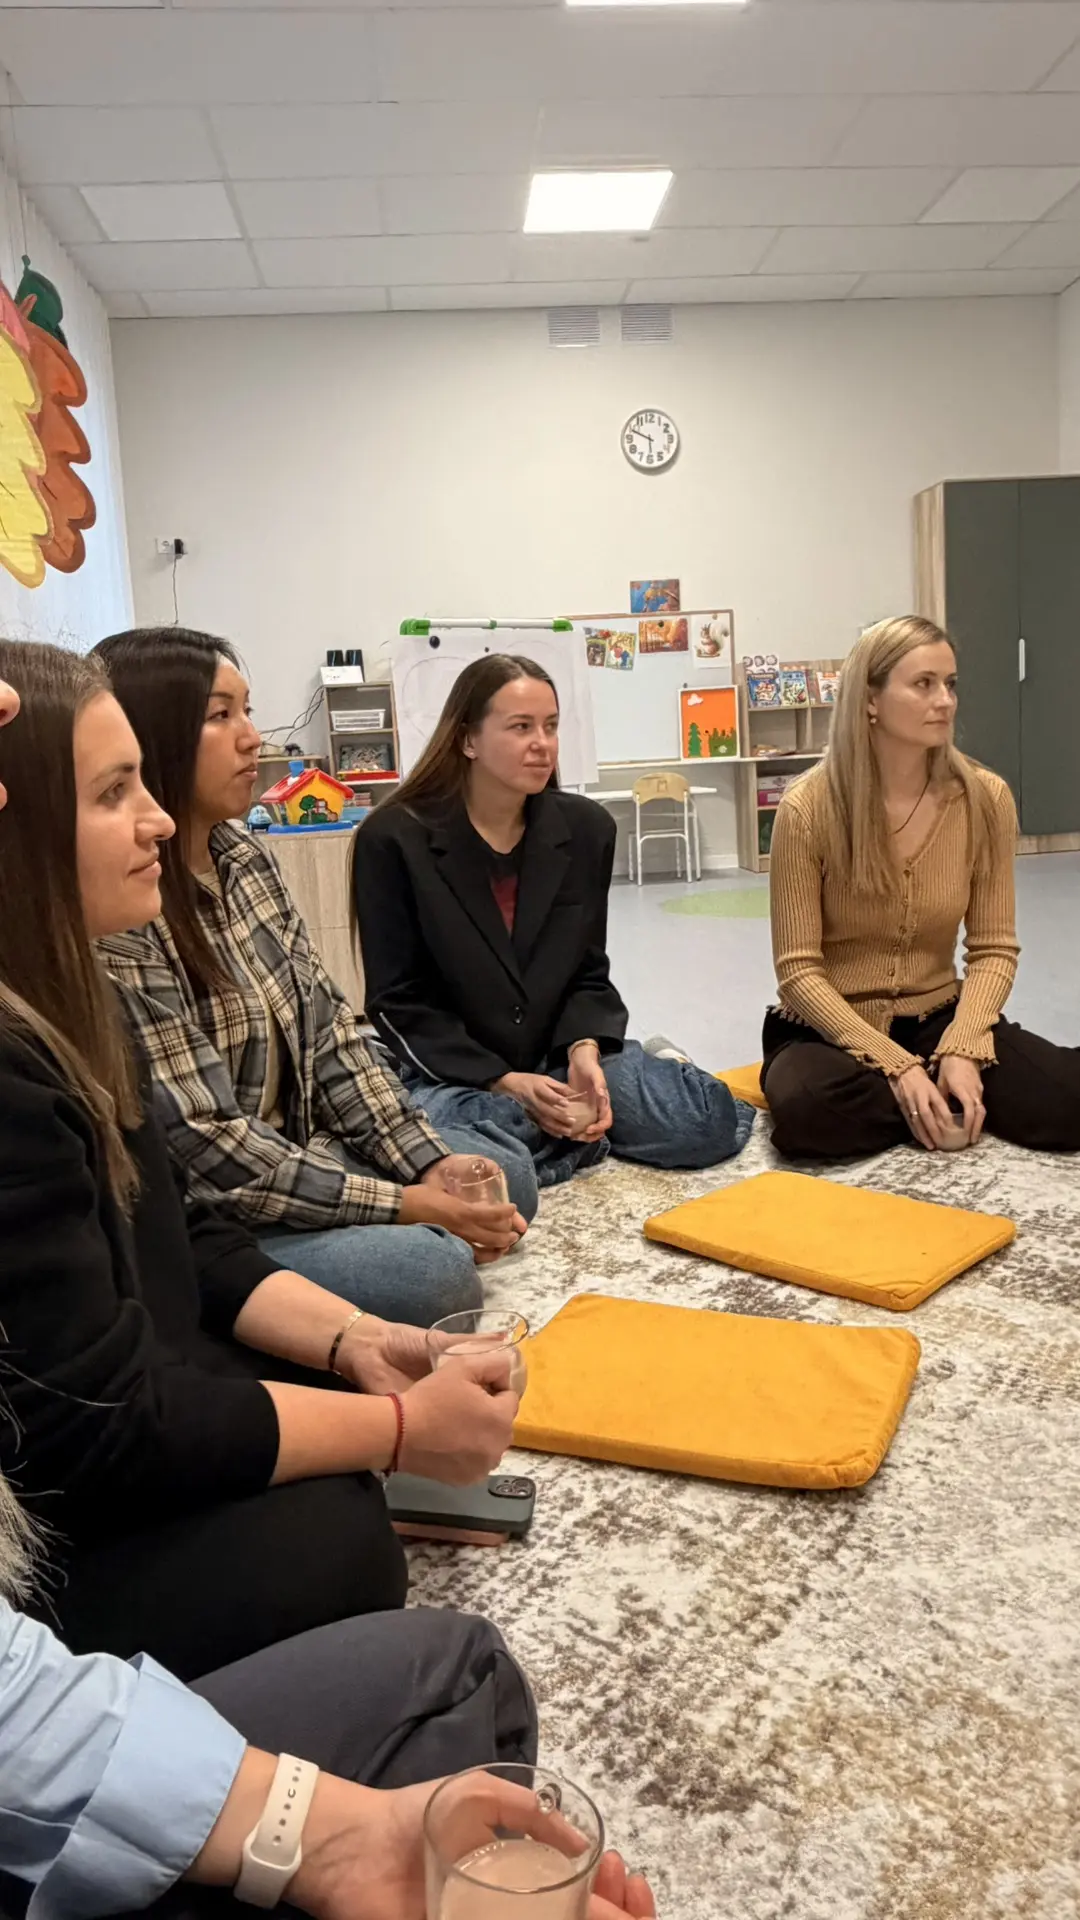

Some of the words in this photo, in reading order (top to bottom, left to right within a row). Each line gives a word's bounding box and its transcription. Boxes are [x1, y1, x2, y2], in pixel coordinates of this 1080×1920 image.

[636, 415, 643, 426] 11
[645, 413, 655, 423] 12
[658, 416, 661, 427] 1
[663, 423, 670, 433] 2
[626, 434, 633, 444] 9
[667, 434, 674, 444] 3
[629, 444, 637, 454] 8
[638, 451, 644, 462] 7
[646, 454, 654, 464] 6
[657, 451, 664, 461] 5
